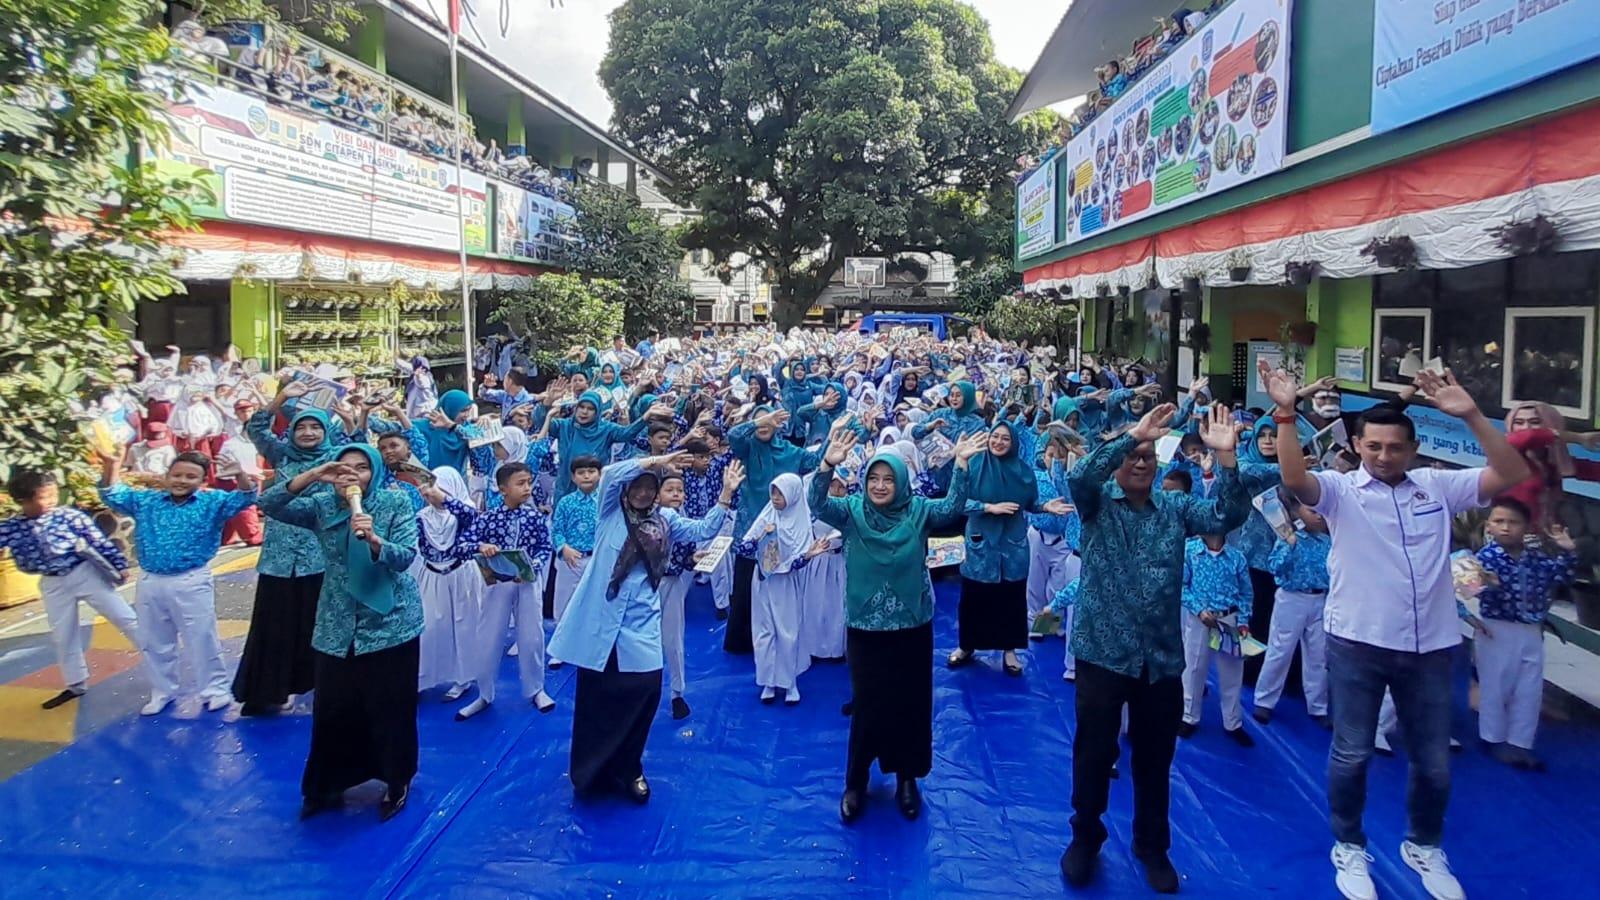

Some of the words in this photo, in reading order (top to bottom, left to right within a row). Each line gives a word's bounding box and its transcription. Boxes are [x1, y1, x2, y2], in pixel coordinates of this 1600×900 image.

[1459, 0, 1481, 12] da
[1376, 56, 1413, 89] Ciptakan
[1416, 36, 1451, 69] Peserta
[1485, 9, 1514, 45] yang
[299, 133, 321, 149] SDN
[324, 142, 364, 161] CITAPEN
[368, 153, 419, 177] TASIKMALAYA
[333, 128, 353, 144] VISI
[356, 138, 375, 151] DAN
[378, 145, 397, 158] MISI
[1432, 436, 1459, 455] yang
